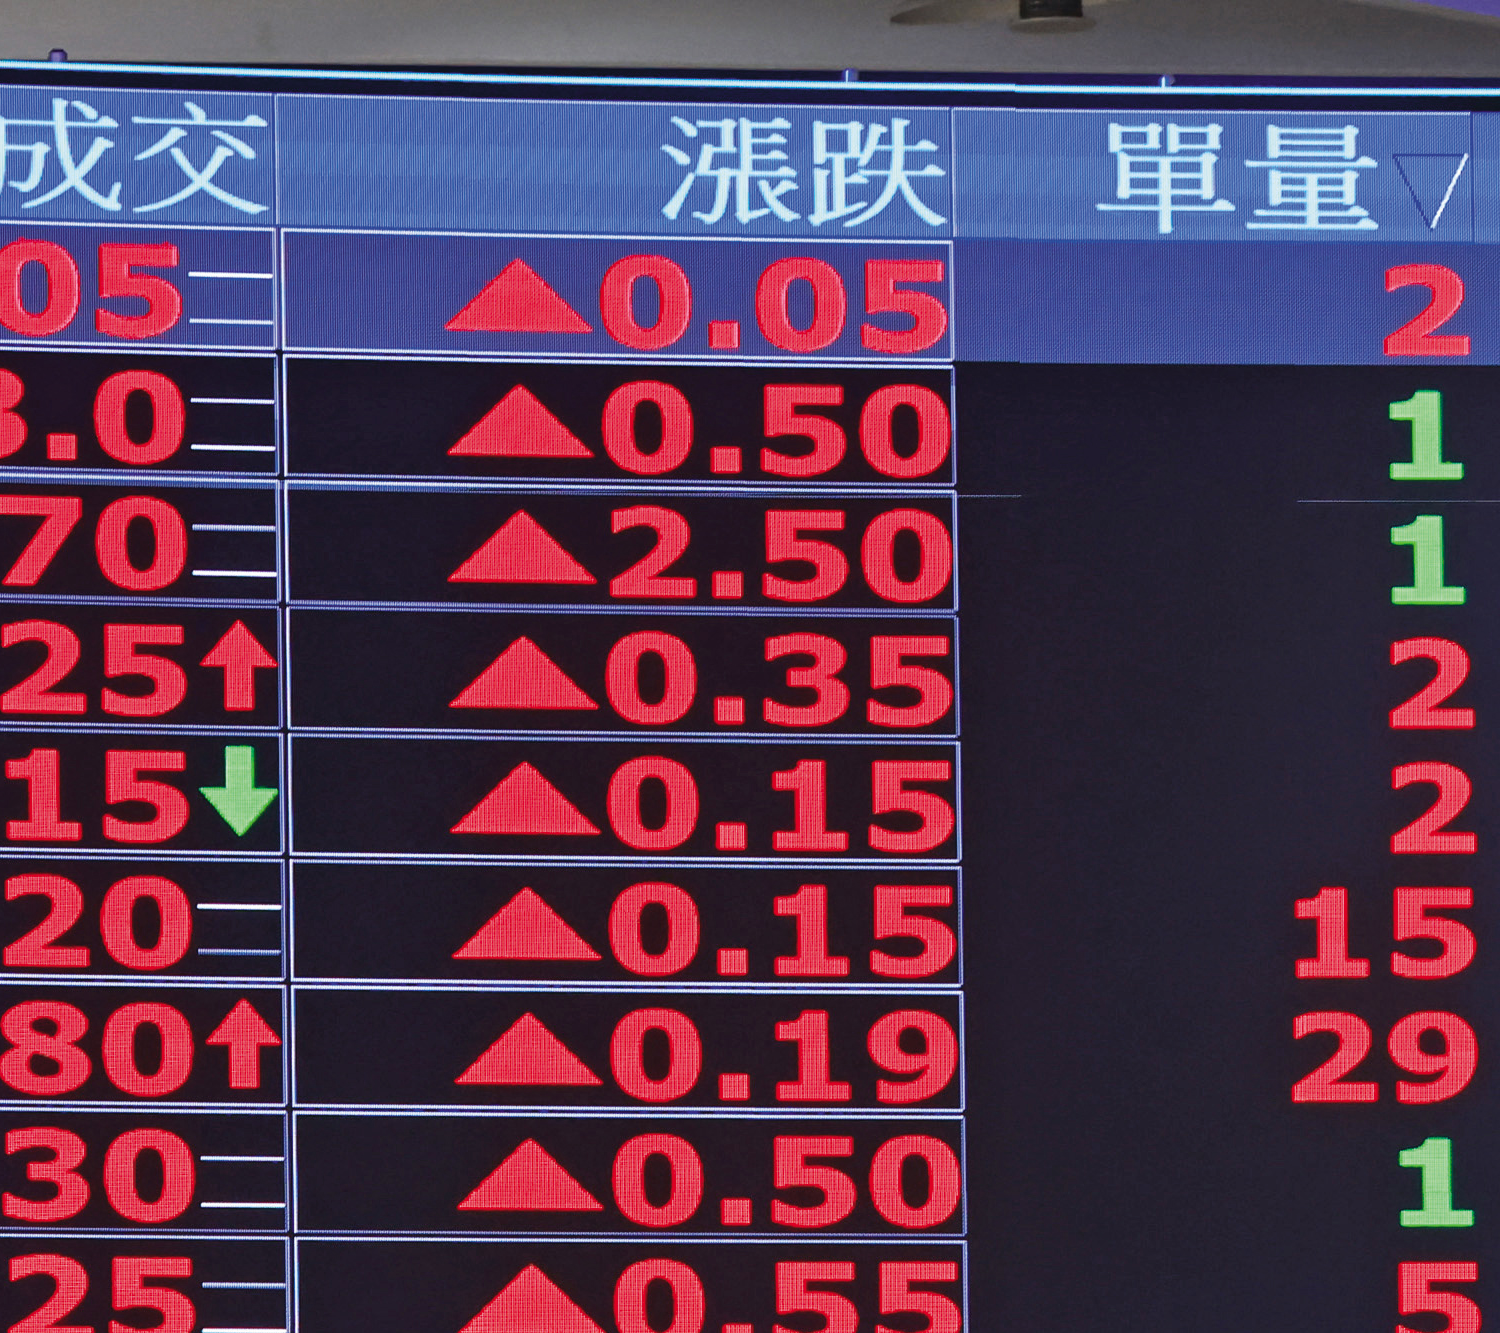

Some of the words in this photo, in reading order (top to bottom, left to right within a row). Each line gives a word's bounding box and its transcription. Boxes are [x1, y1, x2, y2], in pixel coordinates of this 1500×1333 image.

[662, 117, 945, 226] 漲跌
[1098, 123, 1378, 233] 單量
[600, 254, 948, 354] 0.05
[1383, 264, 1471, 356] 2
[610, 1008, 958, 1103] 0.19
[1292, 1011, 1478, 1104] 29
